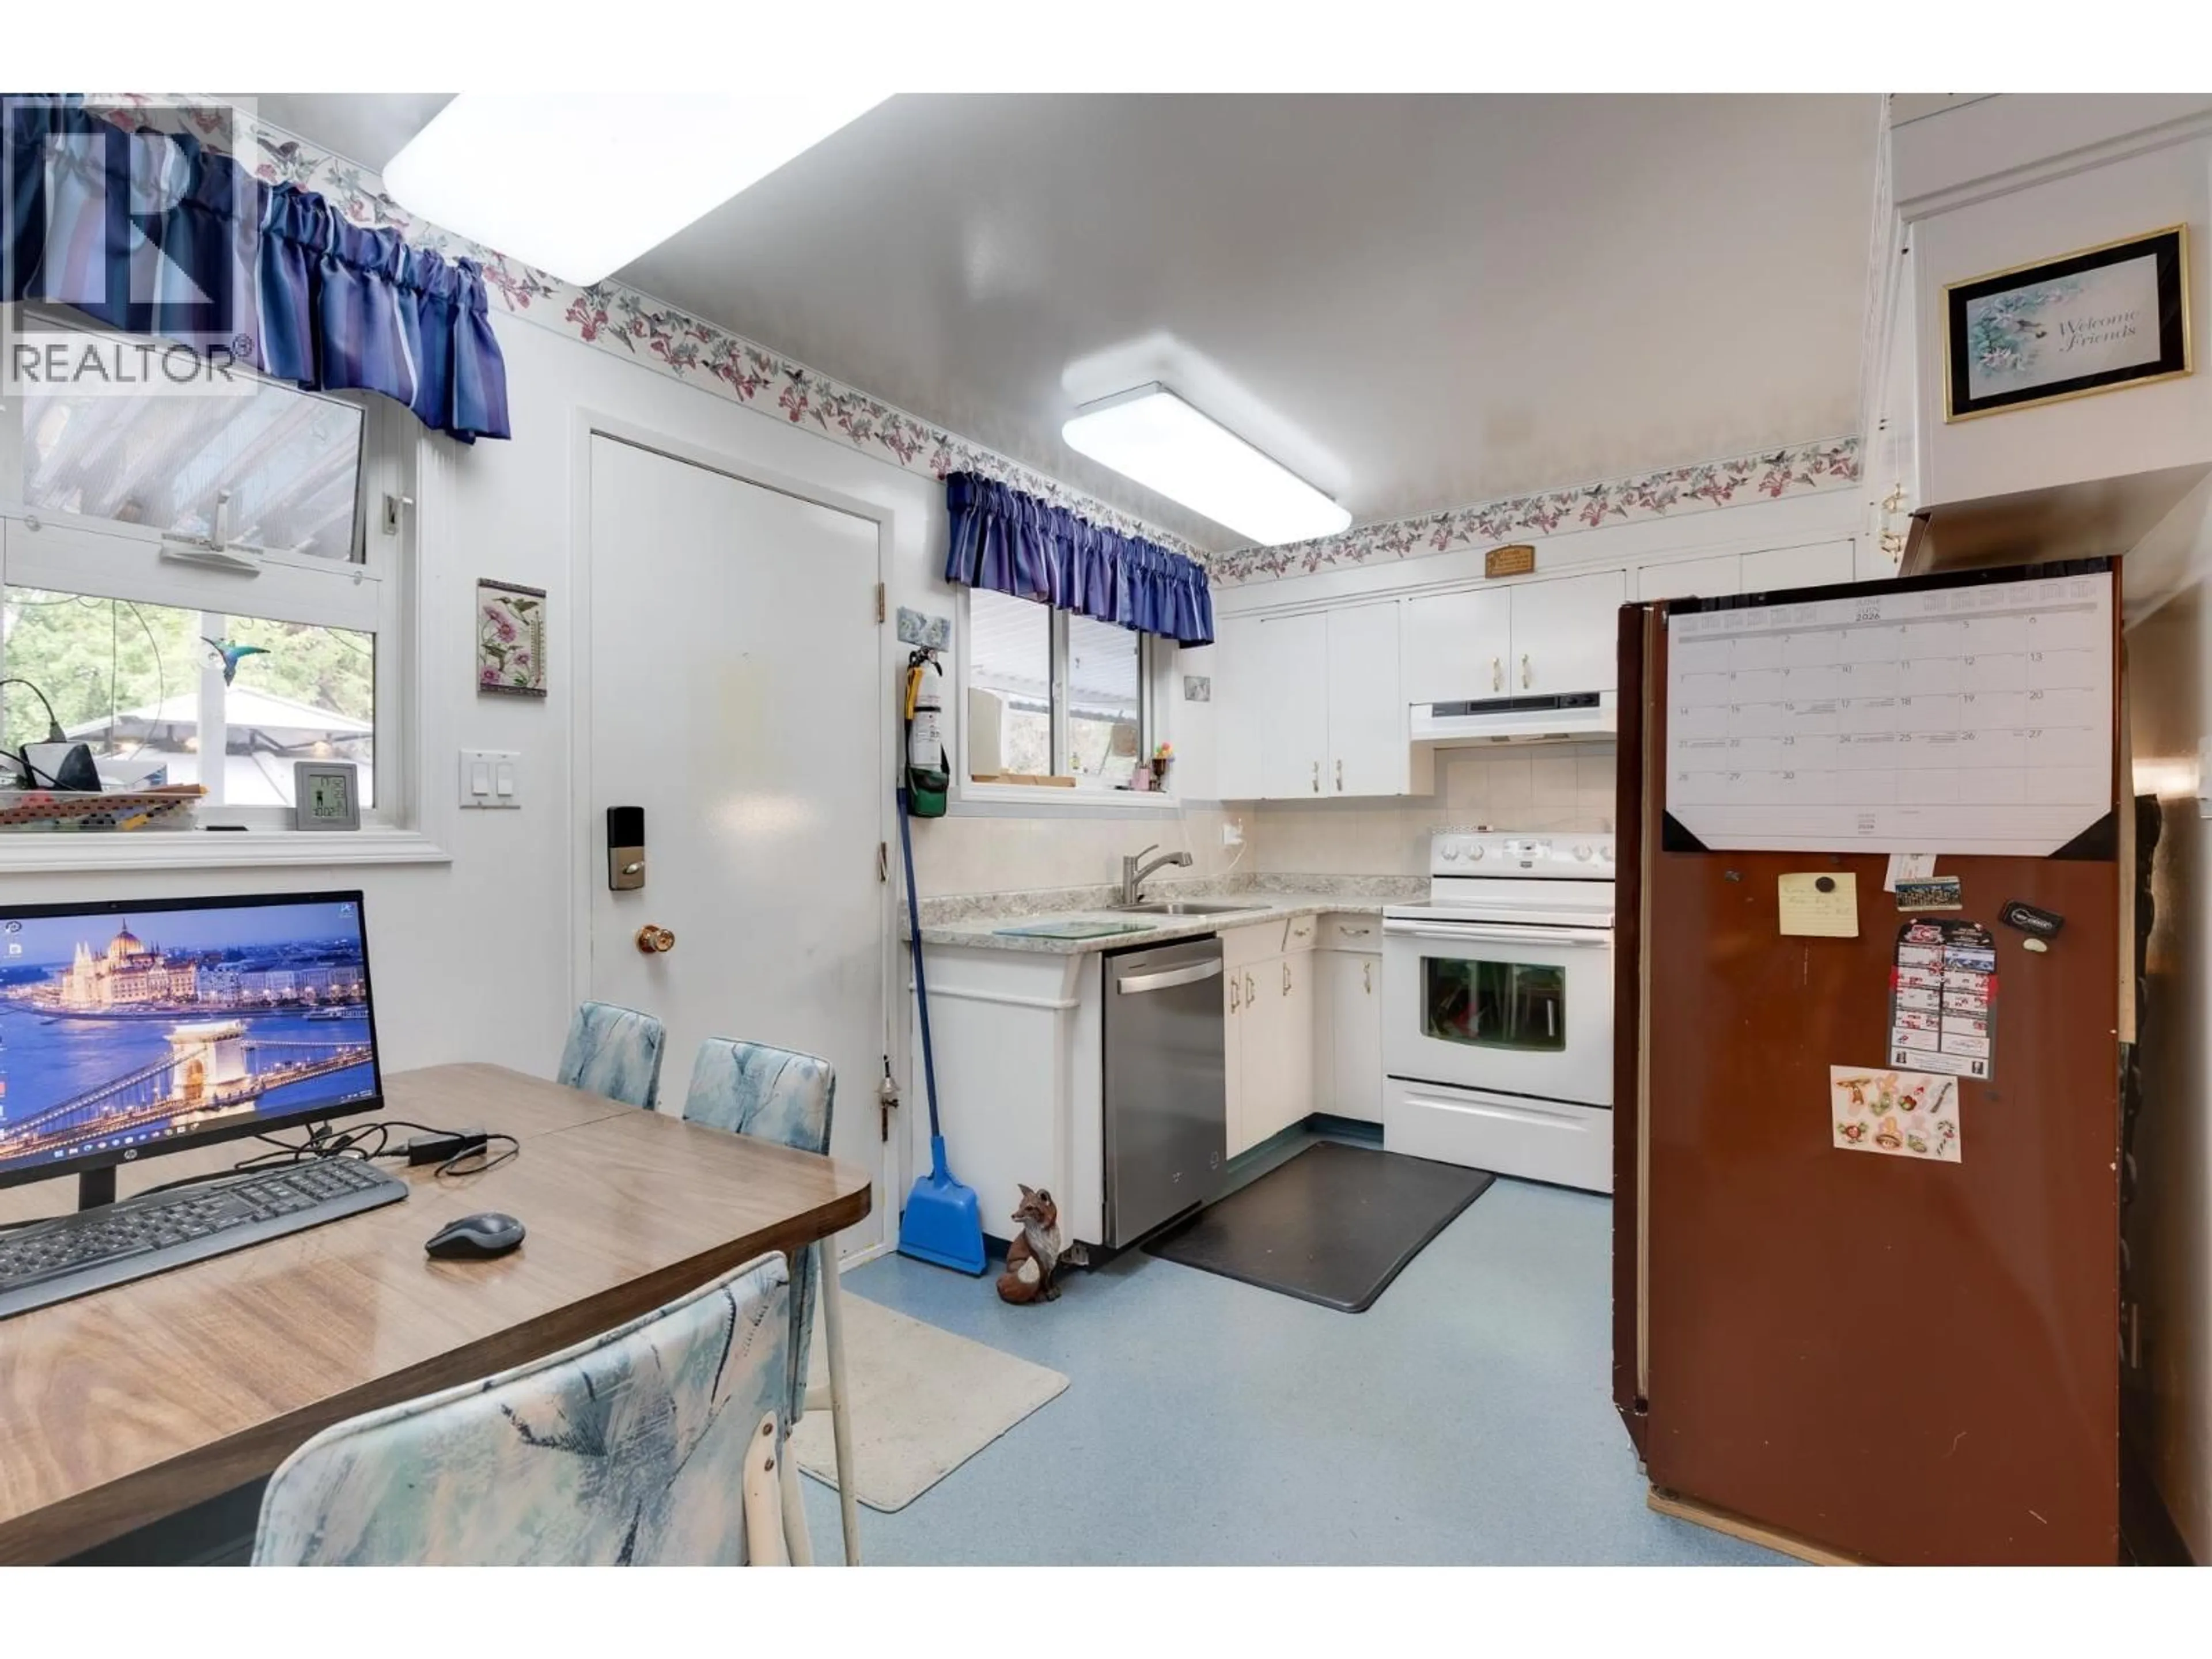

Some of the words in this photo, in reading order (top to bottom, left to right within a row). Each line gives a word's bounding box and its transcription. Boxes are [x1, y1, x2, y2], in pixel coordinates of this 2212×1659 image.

[2059, 309, 2141, 336] Welcome
[2059, 324, 2136, 353] Friends
[1856, 613, 1880, 622] 2026
[1784, 668, 1790, 676] 9
[1964, 657, 1975, 665] 12
[2030, 653, 2043, 661] 13
[1785, 703, 1794, 711] 16
[1841, 700, 1851, 709] 17
[1900, 698, 1911, 706] 18
[1964, 695, 1975, 703] 19
[2029, 691, 2044, 699] 20
[1782, 737, 1794, 745] 23
[1839, 735, 1851, 743] 24
[1899, 734, 1912, 742] 25
[1961, 732, 1975, 740] 26
[2028, 730, 2041, 738] 27
[1729, 772, 1741, 781] 29
